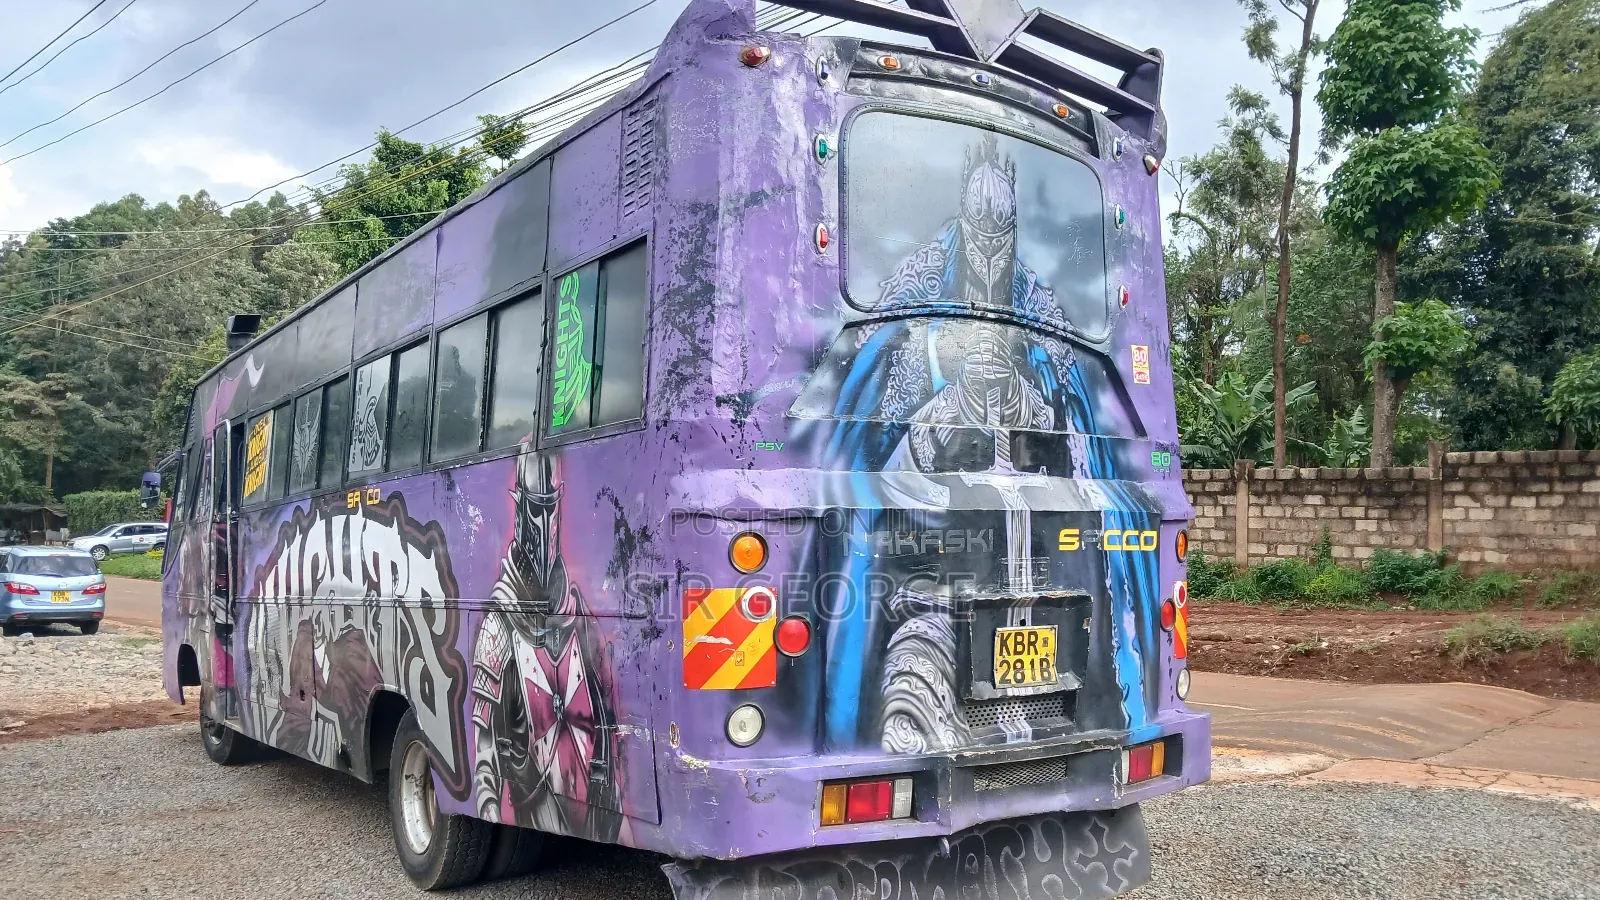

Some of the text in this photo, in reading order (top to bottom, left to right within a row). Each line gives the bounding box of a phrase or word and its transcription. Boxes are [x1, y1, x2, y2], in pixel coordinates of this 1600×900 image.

[552, 274, 572, 427] KNIGHTS
[755, 442, 784, 451] PSV
[1151, 451, 1170, 466] 80
[998, 630, 1039, 657] KBR
[998, 657, 1052, 685] 281B
